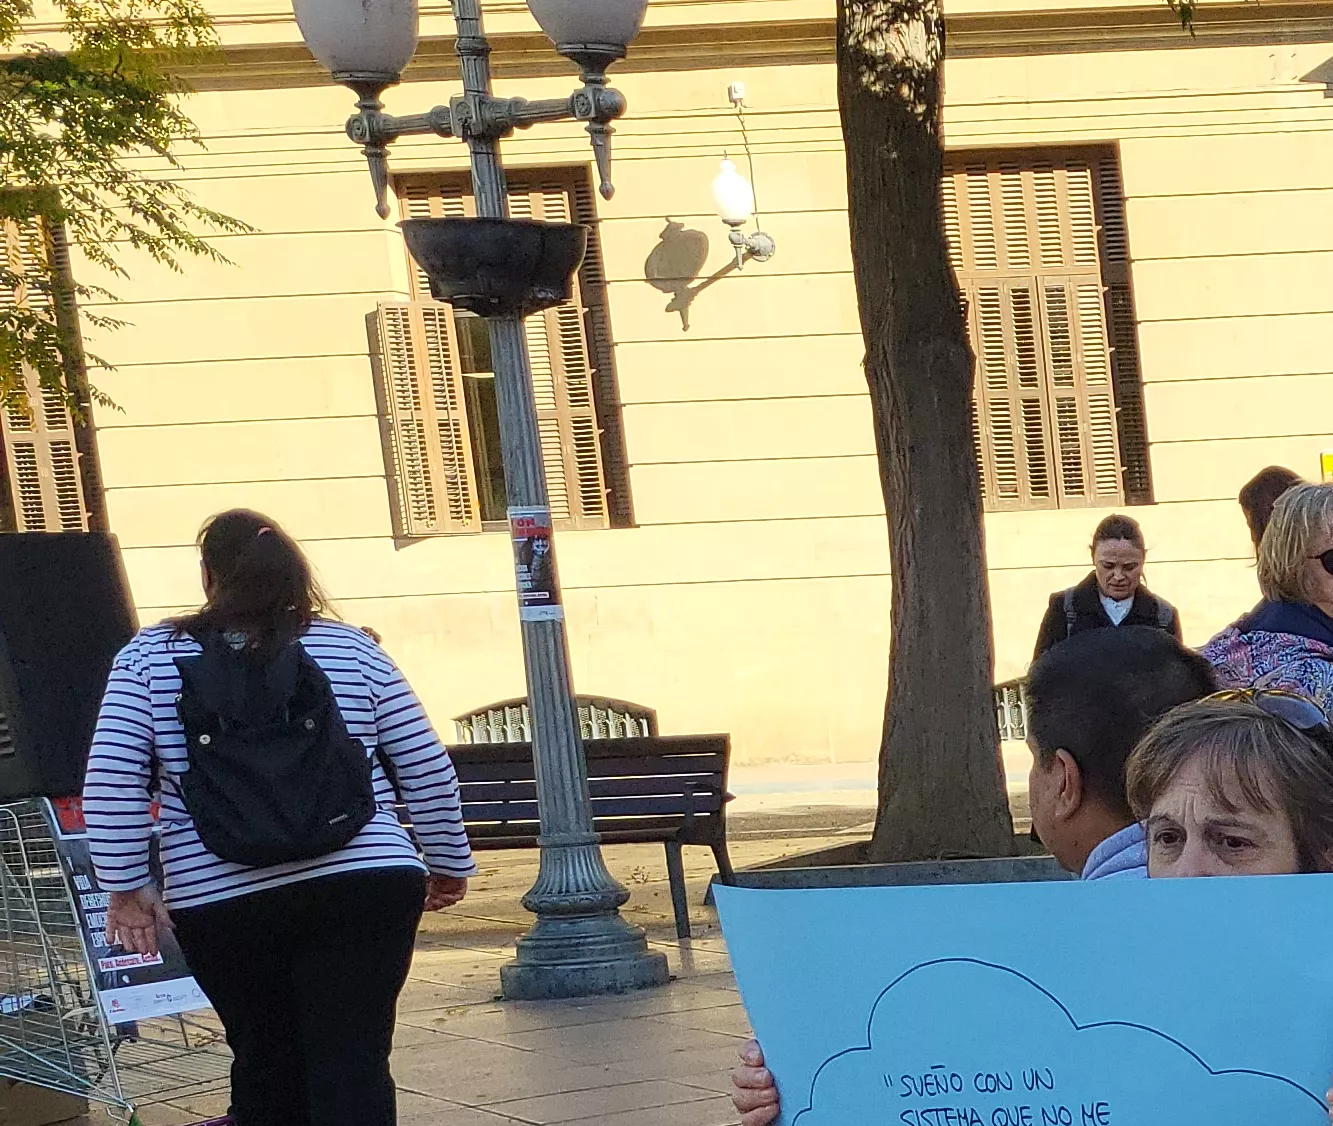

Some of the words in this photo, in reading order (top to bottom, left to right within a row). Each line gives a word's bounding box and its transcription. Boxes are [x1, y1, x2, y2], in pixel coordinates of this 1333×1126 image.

[974, 1071, 1012, 1093] CON
[1023, 1068, 1053, 1091] UN
[1042, 1105, 1072, 1126] NO
